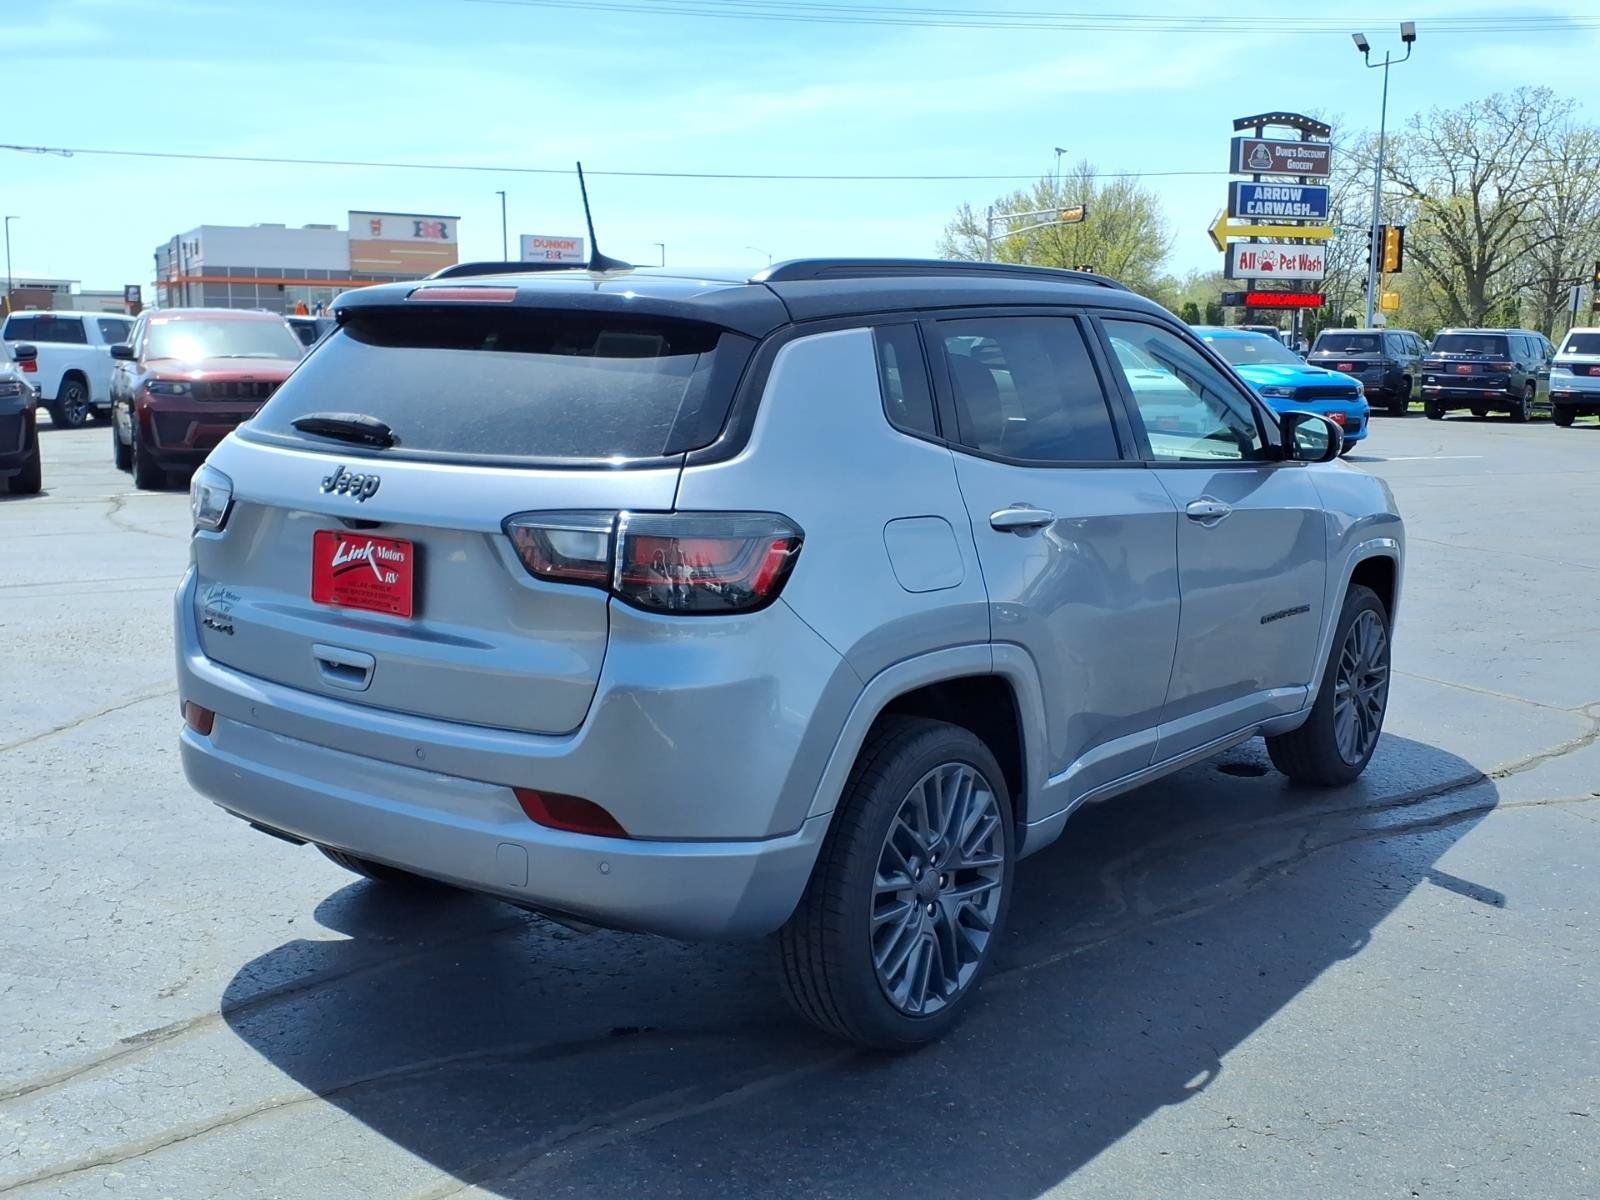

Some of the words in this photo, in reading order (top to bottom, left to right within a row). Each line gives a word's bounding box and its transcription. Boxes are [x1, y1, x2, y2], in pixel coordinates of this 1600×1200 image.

[1297, 147, 1326, 159] DISCOUNT
[1286, 159, 1314, 170] GROCERY
[1253, 186, 1303, 201] ARROW
[1246, 201, 1310, 216] CARWASH
[1239, 251, 1257, 270] All
[1279, 253, 1297, 270] Pet
[1298, 253, 1322, 272] Wash
[320, 464, 381, 503] Jeep
[331, 540, 383, 582] Link
[377, 545, 405, 562] Motors
[385, 571, 399, 583] RV
